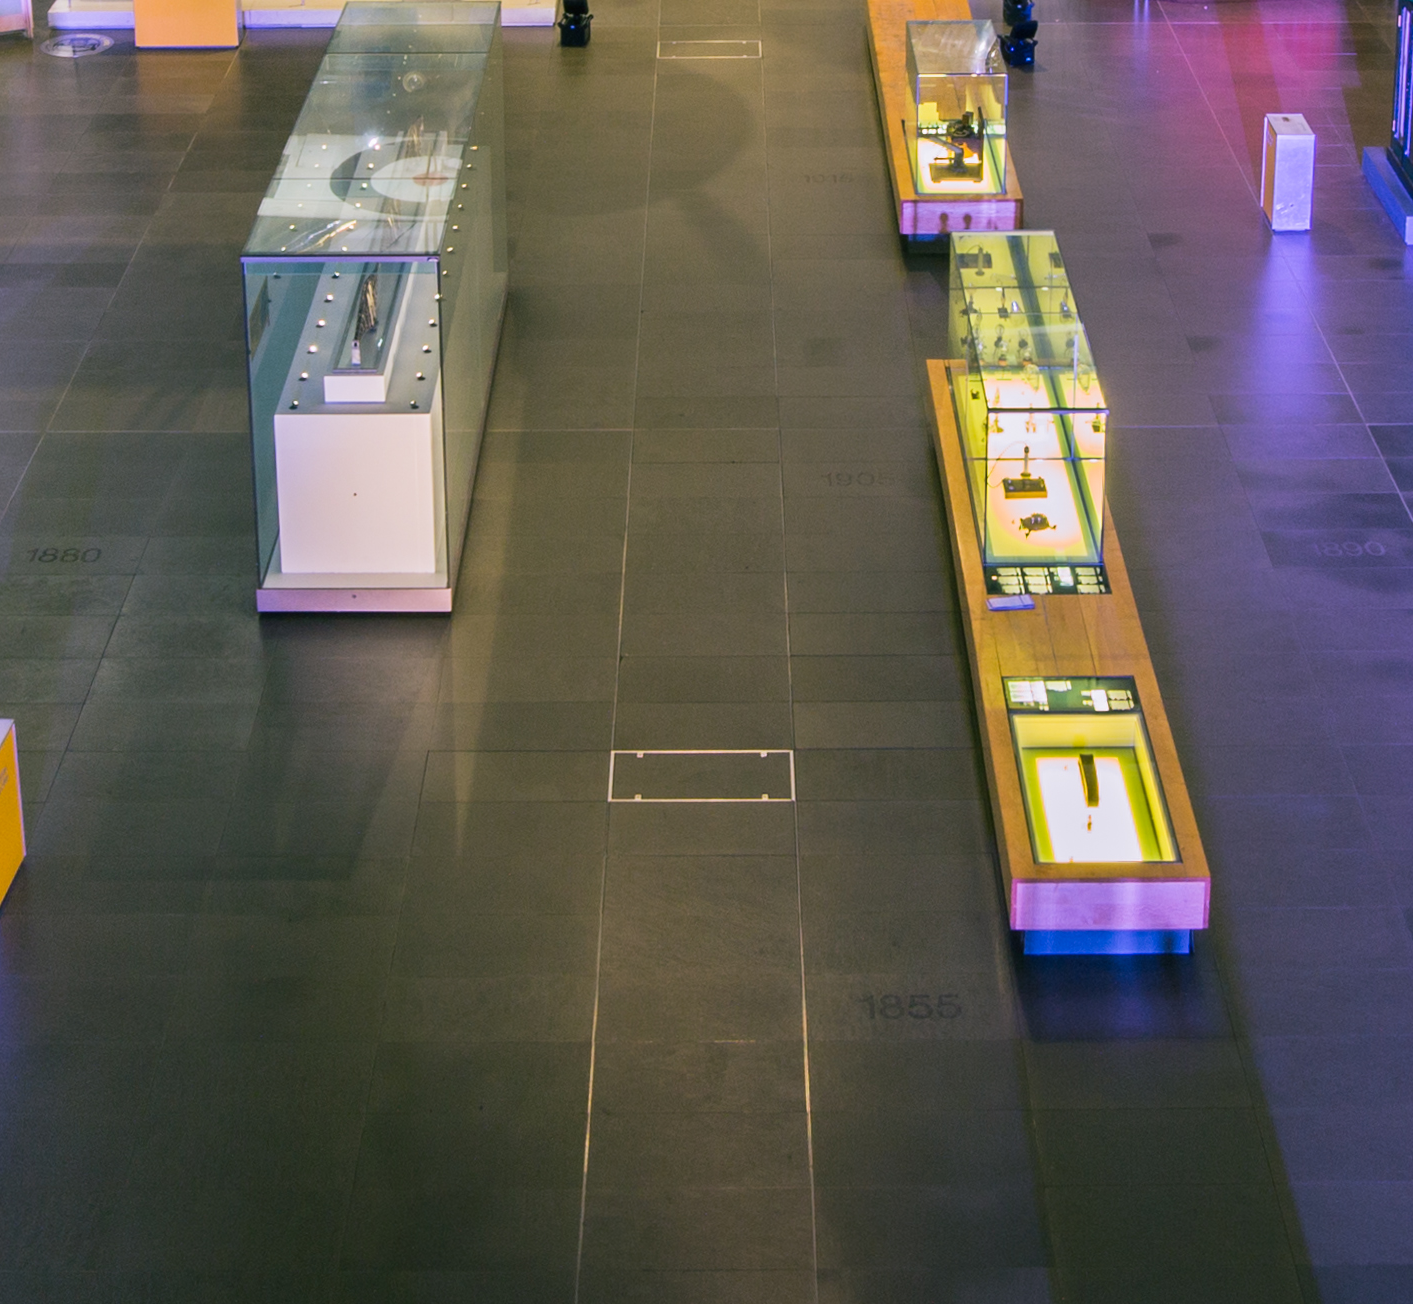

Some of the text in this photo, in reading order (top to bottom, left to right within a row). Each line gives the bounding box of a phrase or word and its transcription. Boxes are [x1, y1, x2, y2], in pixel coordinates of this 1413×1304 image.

[27, 547, 102, 563] 1880
[1313, 540, 1386, 557] 1890
[857, 994, 962, 1019] 1855
